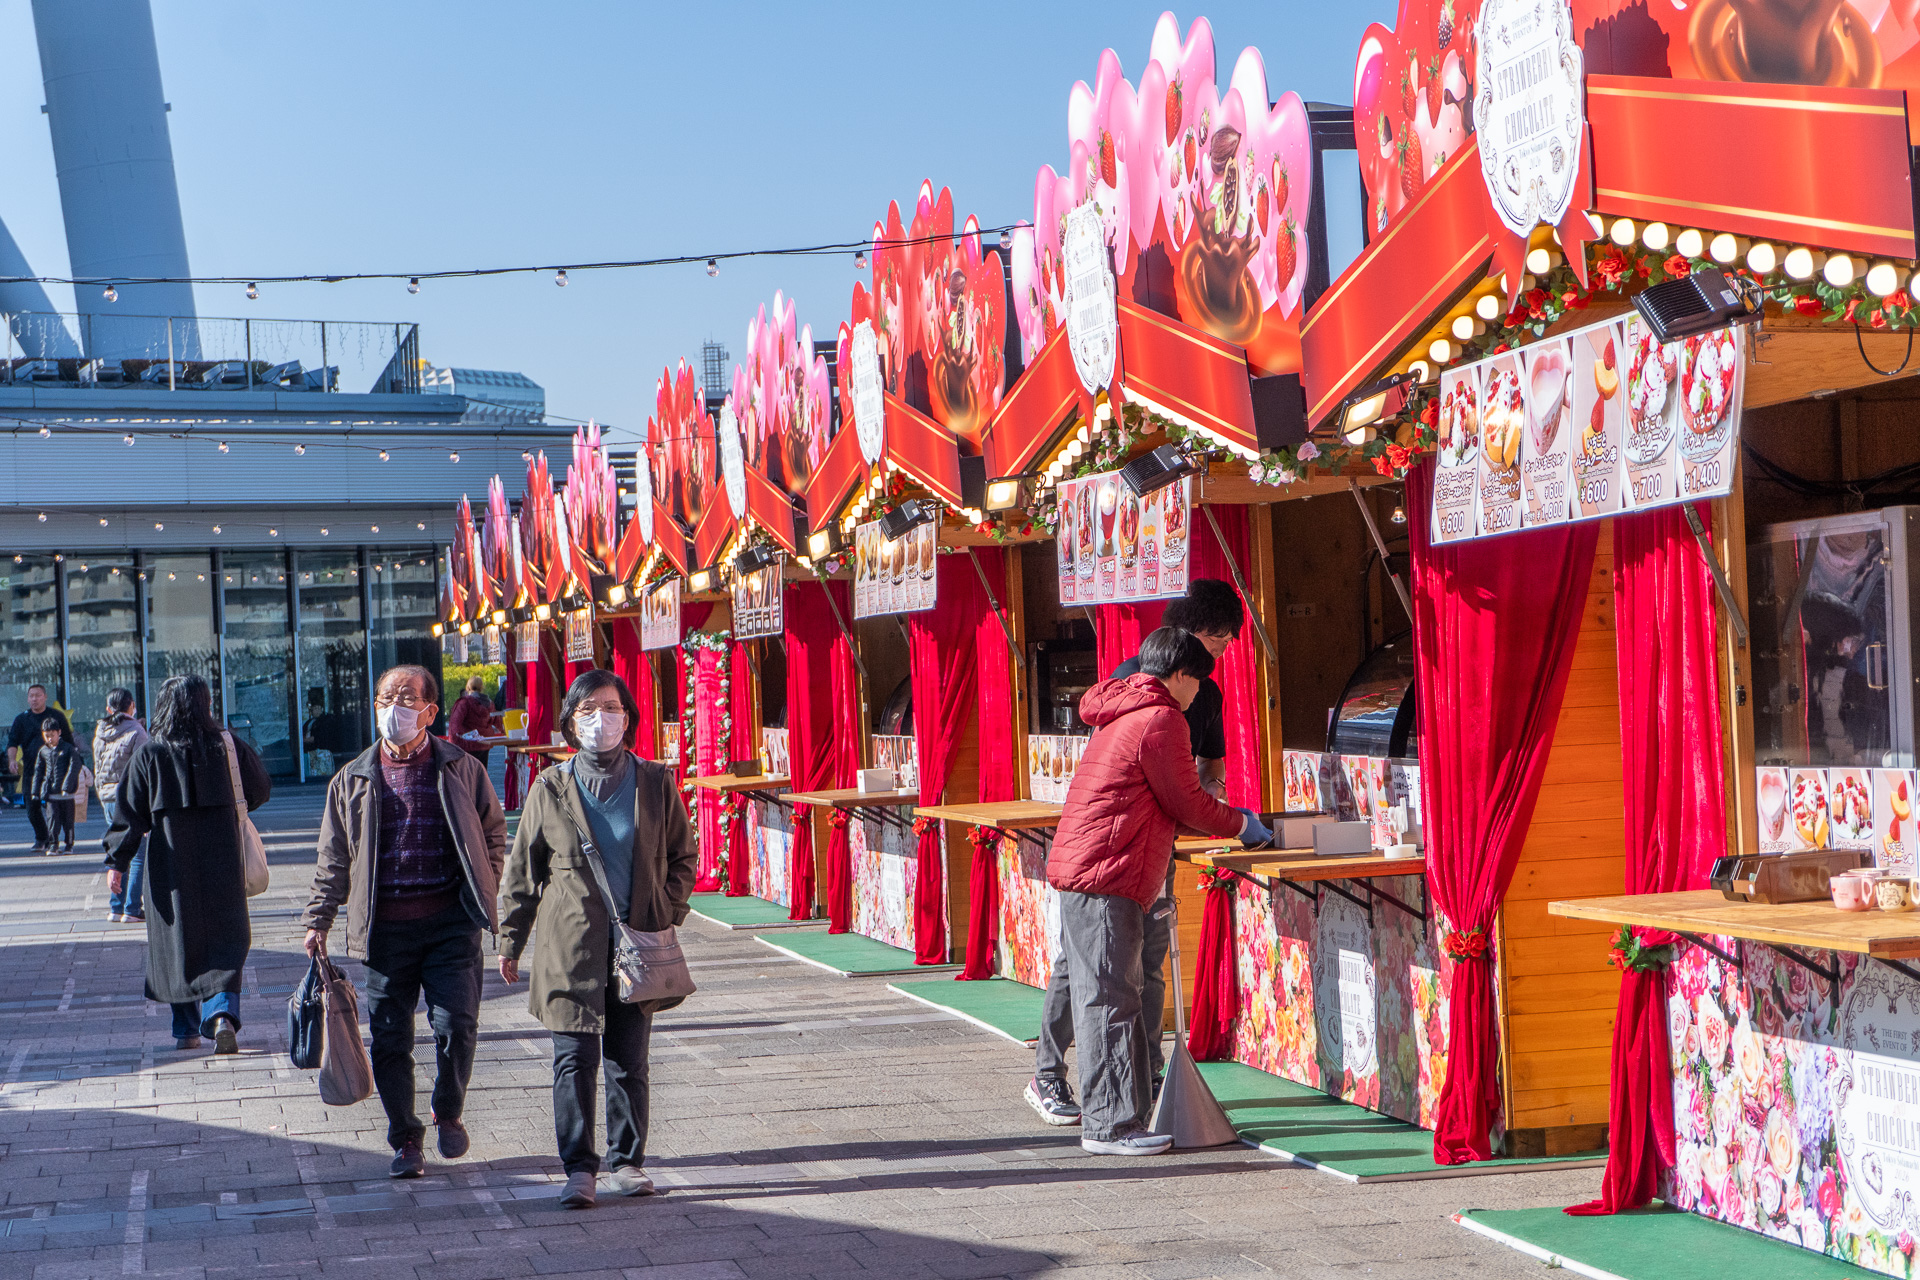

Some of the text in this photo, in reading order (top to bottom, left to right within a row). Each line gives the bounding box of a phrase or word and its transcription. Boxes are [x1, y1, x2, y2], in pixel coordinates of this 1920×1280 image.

[1497, 46, 1554, 101] STRAWBERRY
[1504, 94, 1556, 145] CHOCOLATE
[1637, 413, 1663, 432] いちごの
[1693, 410, 1718, 429] いちごの
[1628, 426, 1670, 450] バウムクーヘン
[1682, 427, 1726, 450] バウムクーヘン
[1633, 473, 1662, 500] ¥700
[1684, 460, 1720, 492] ¥1,400
[1544, 481, 1564, 499] ¥600
[1580, 478, 1608, 504] ¥600
[1441, 511, 1464, 533] ¥600
[1483, 505, 1513, 532] ¥1,200
[1882, 1028, 1907, 1040] THE FIRST
[1882, 1040, 1907, 1052] EVENT OF
[1861, 1065, 1920, 1105] STRAWBER
